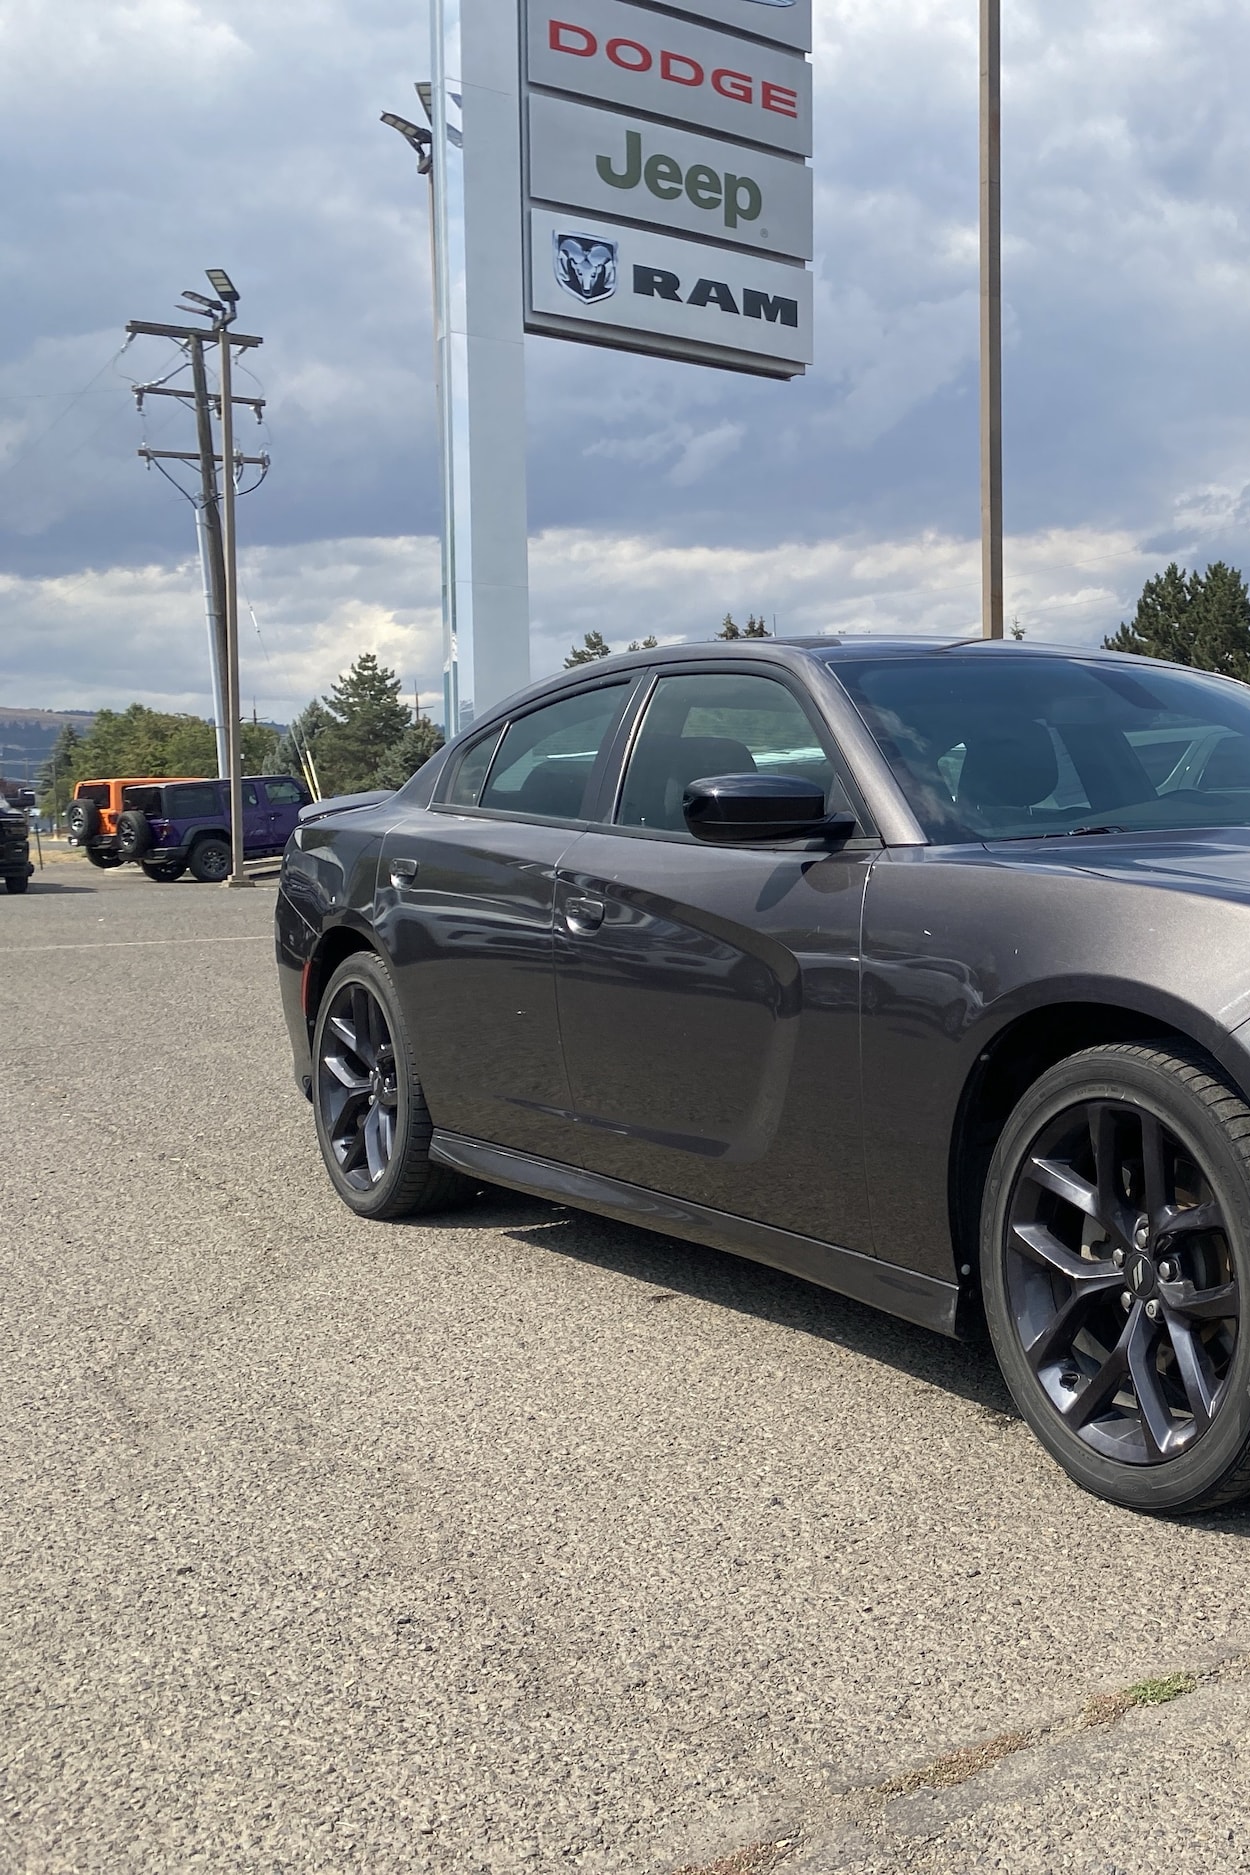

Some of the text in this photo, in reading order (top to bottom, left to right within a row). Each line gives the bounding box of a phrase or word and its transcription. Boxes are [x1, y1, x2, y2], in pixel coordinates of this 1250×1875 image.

[548, 19, 798, 119] DODGE
[595, 130, 763, 229] Jeep
[633, 264, 798, 328] RAM
